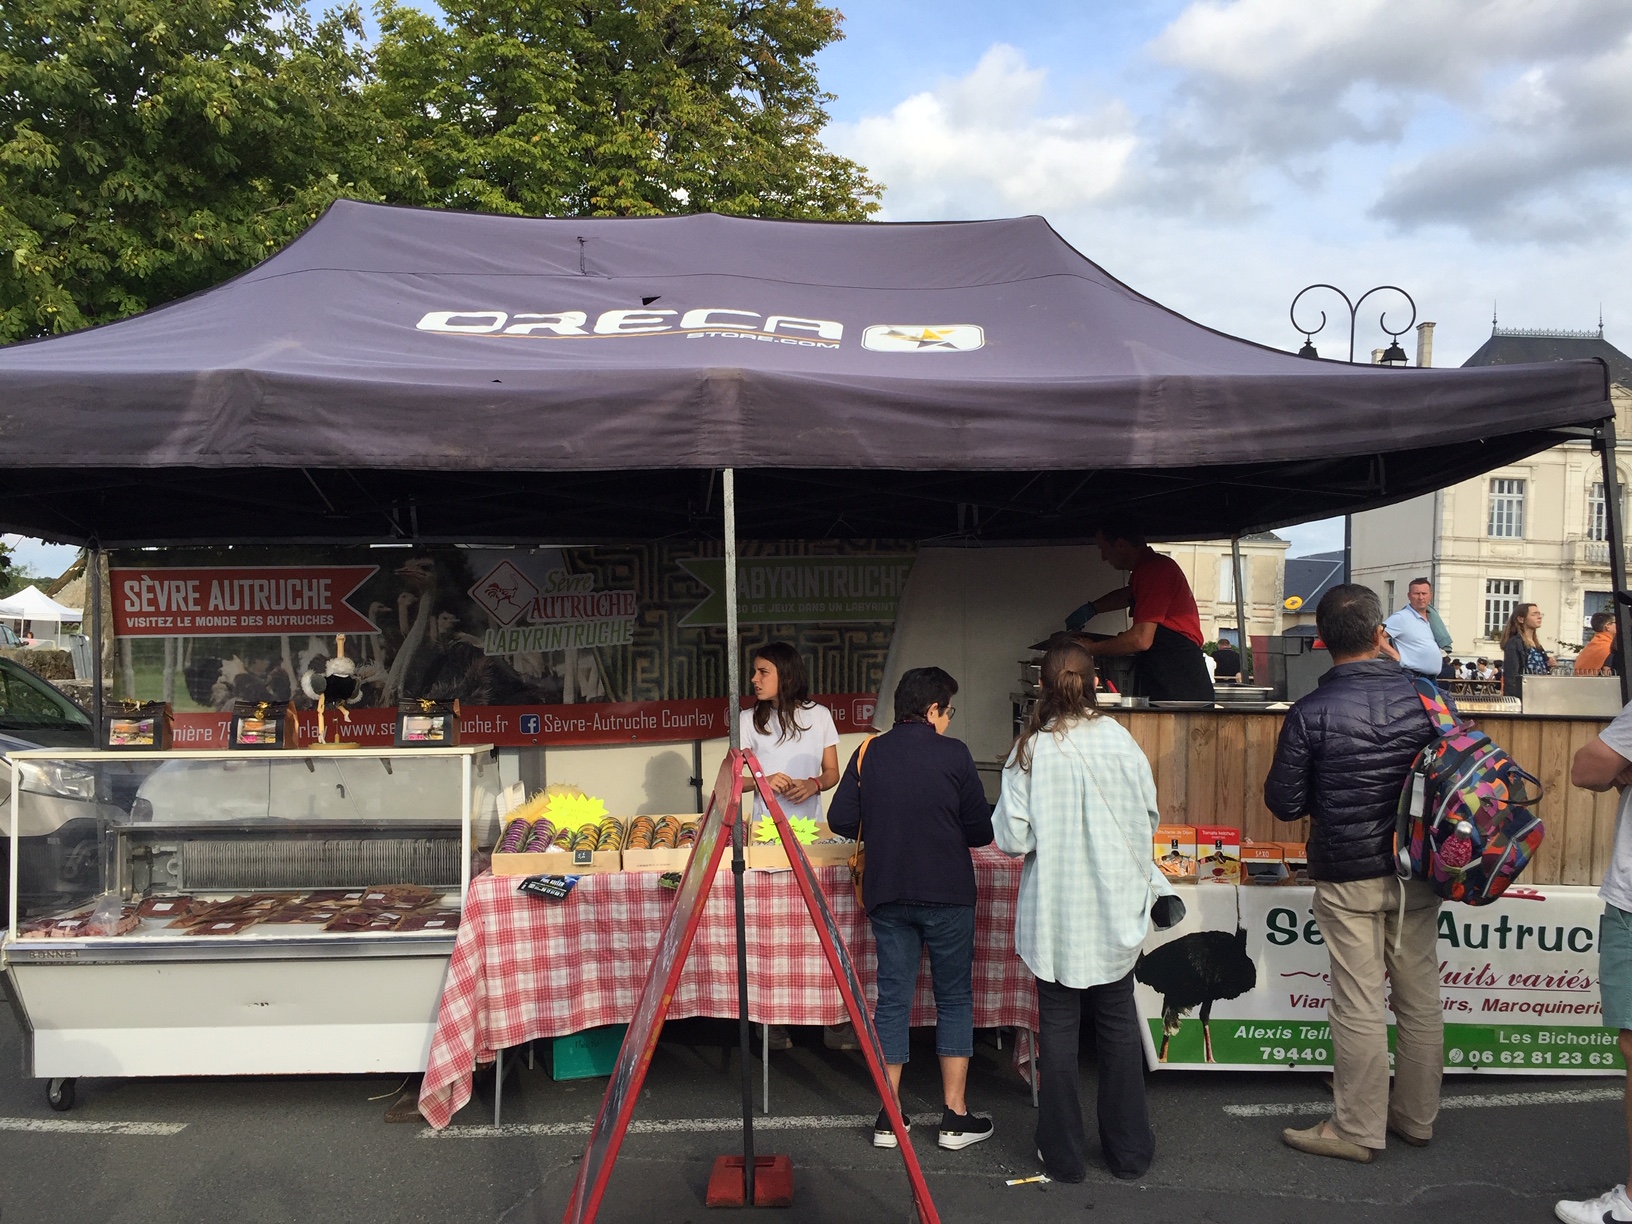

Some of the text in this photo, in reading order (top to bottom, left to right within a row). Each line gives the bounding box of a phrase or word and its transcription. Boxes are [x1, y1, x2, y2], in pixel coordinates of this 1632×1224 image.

[415, 308, 844, 341] ORECA
[686, 332, 841, 349] STORE.COM
[545, 570, 592, 594] Sèvre
[736, 565, 908, 599] ABYRINTRUCHE
[124, 575, 332, 612] SÈVRE AUTRUCHE
[530, 593, 636, 620] AUTRUCHE
[768, 603, 795, 614] JEUX
[798, 603, 826, 613] DANS
[845, 601, 897, 612] LABYRINT
[126, 615, 334, 627] VISITEZ LE MONDE DES AUTRUCHES
[486, 619, 634, 654] LABYRINTRUCHE
[172, 724, 213, 742] nière
[544, 711, 657, 733] Sèvre-Autruche
[662, 708, 714, 729] Courlay
[1234, 1026, 1293, 1040] Alexis
[1499, 1031, 1619, 1046] Les Bichotièr
[1259, 1047, 1328, 1061] 79440
[1468, 1050, 1614, 1065] 06 62 81 23 63
